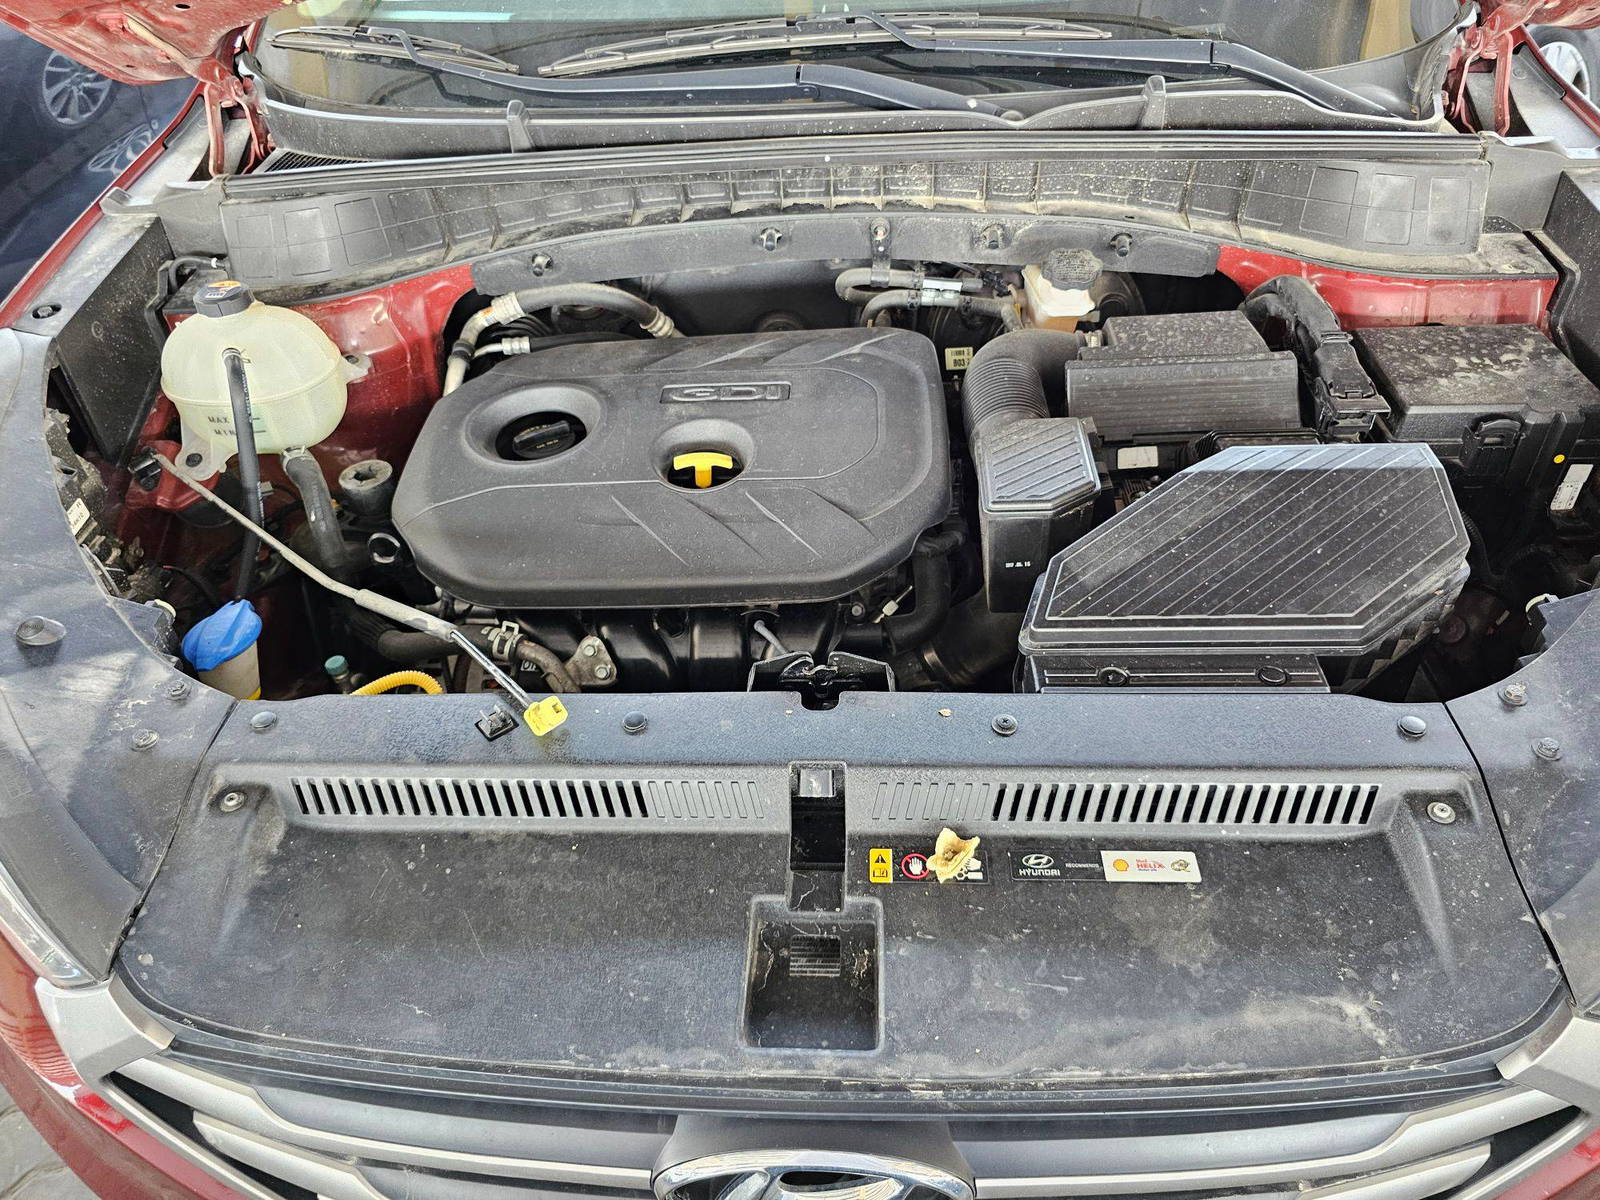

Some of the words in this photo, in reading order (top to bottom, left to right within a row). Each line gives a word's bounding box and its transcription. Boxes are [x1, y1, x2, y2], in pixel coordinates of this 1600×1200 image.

[671, 386, 781, 401] GDI
[207, 416, 230, 424] MAX
[1018, 868, 1061, 877] HYUNDAI
